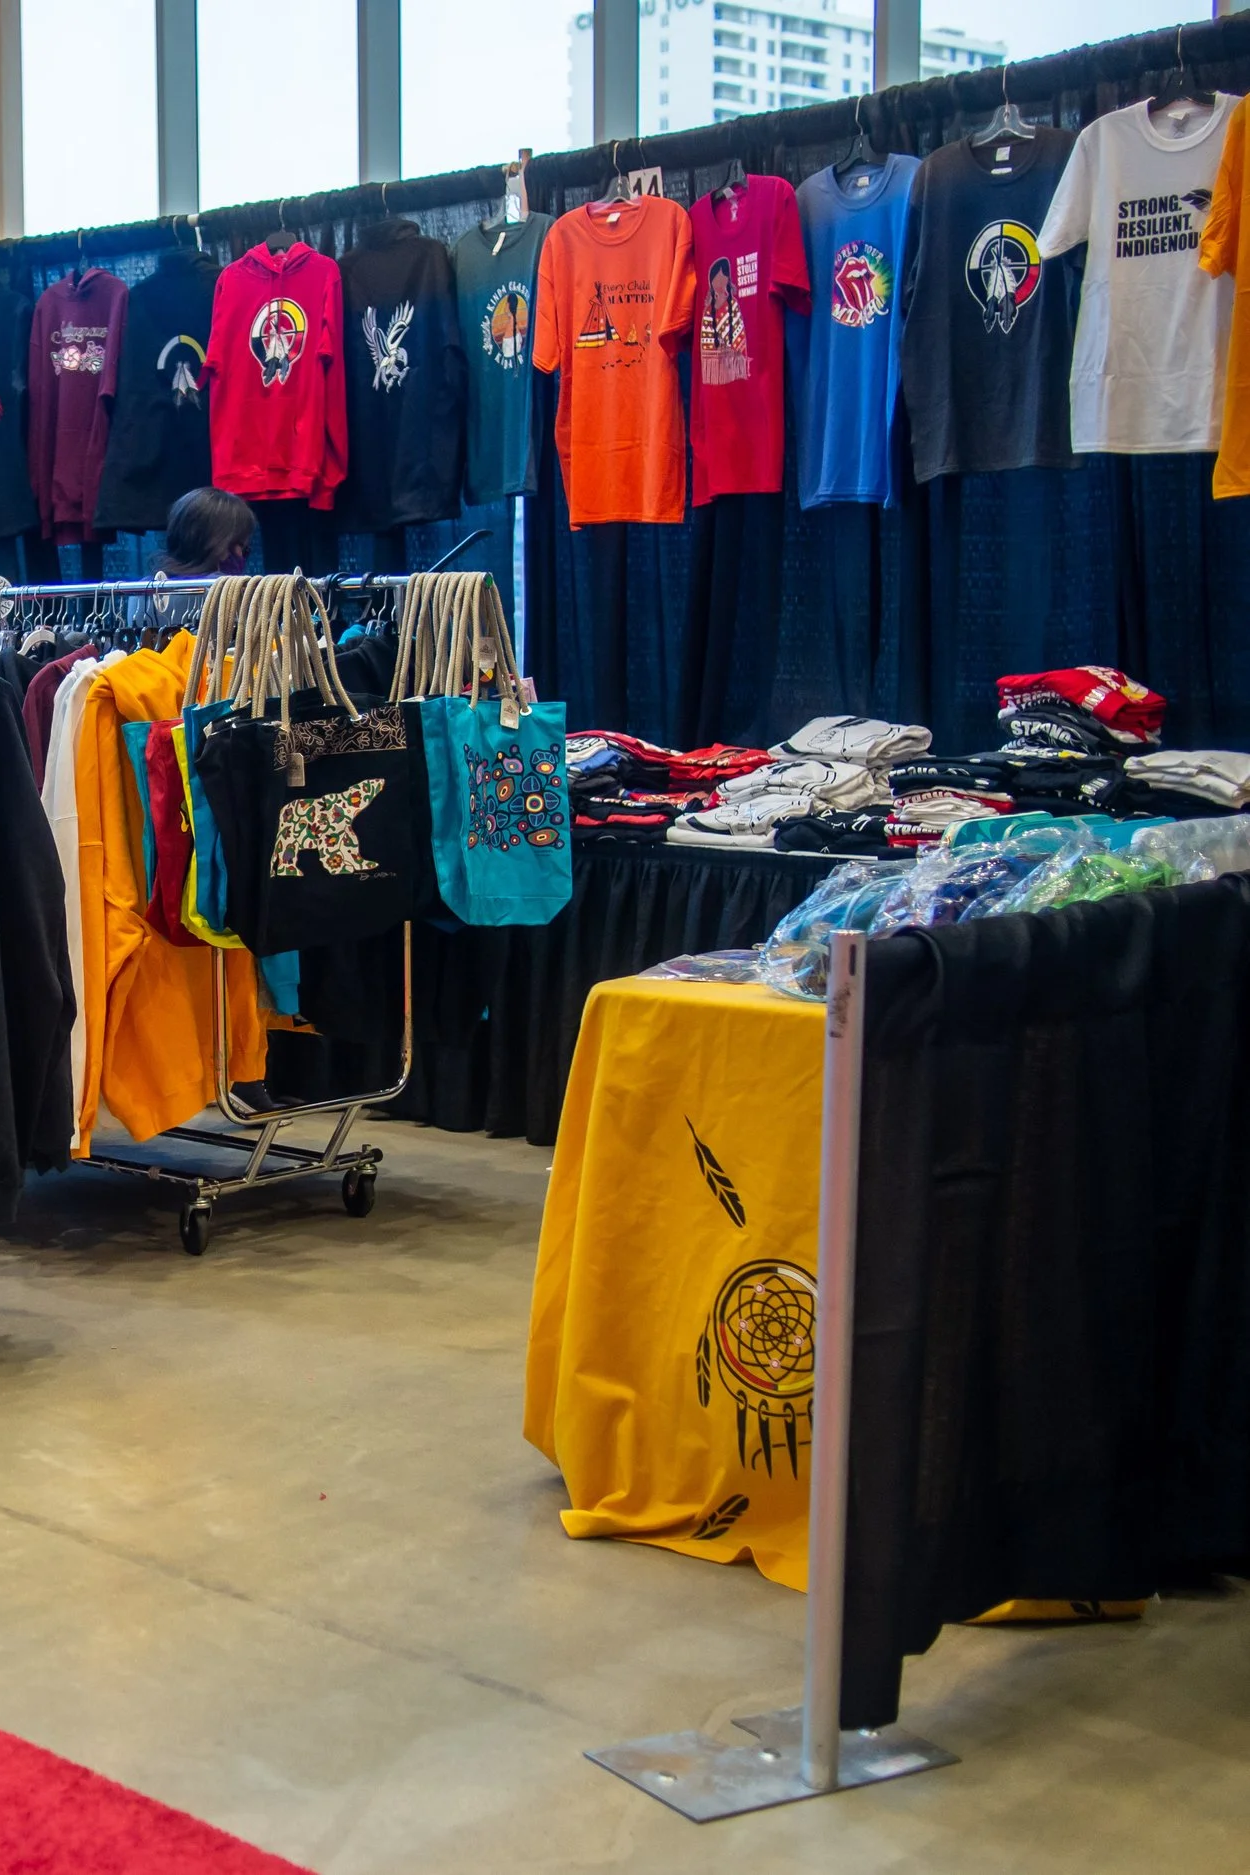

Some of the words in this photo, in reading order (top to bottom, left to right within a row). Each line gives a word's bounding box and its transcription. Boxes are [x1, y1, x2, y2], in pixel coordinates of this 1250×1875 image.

[633, 174, 661, 197] 14
[1118, 195, 1182, 219] STRONG.
[1117, 213, 1192, 239] RESILIENT.
[835, 243, 859, 266] ORLD
[1116, 231, 1202, 258] INDIGENOU
[1010, 720, 1072, 745] STRONG
